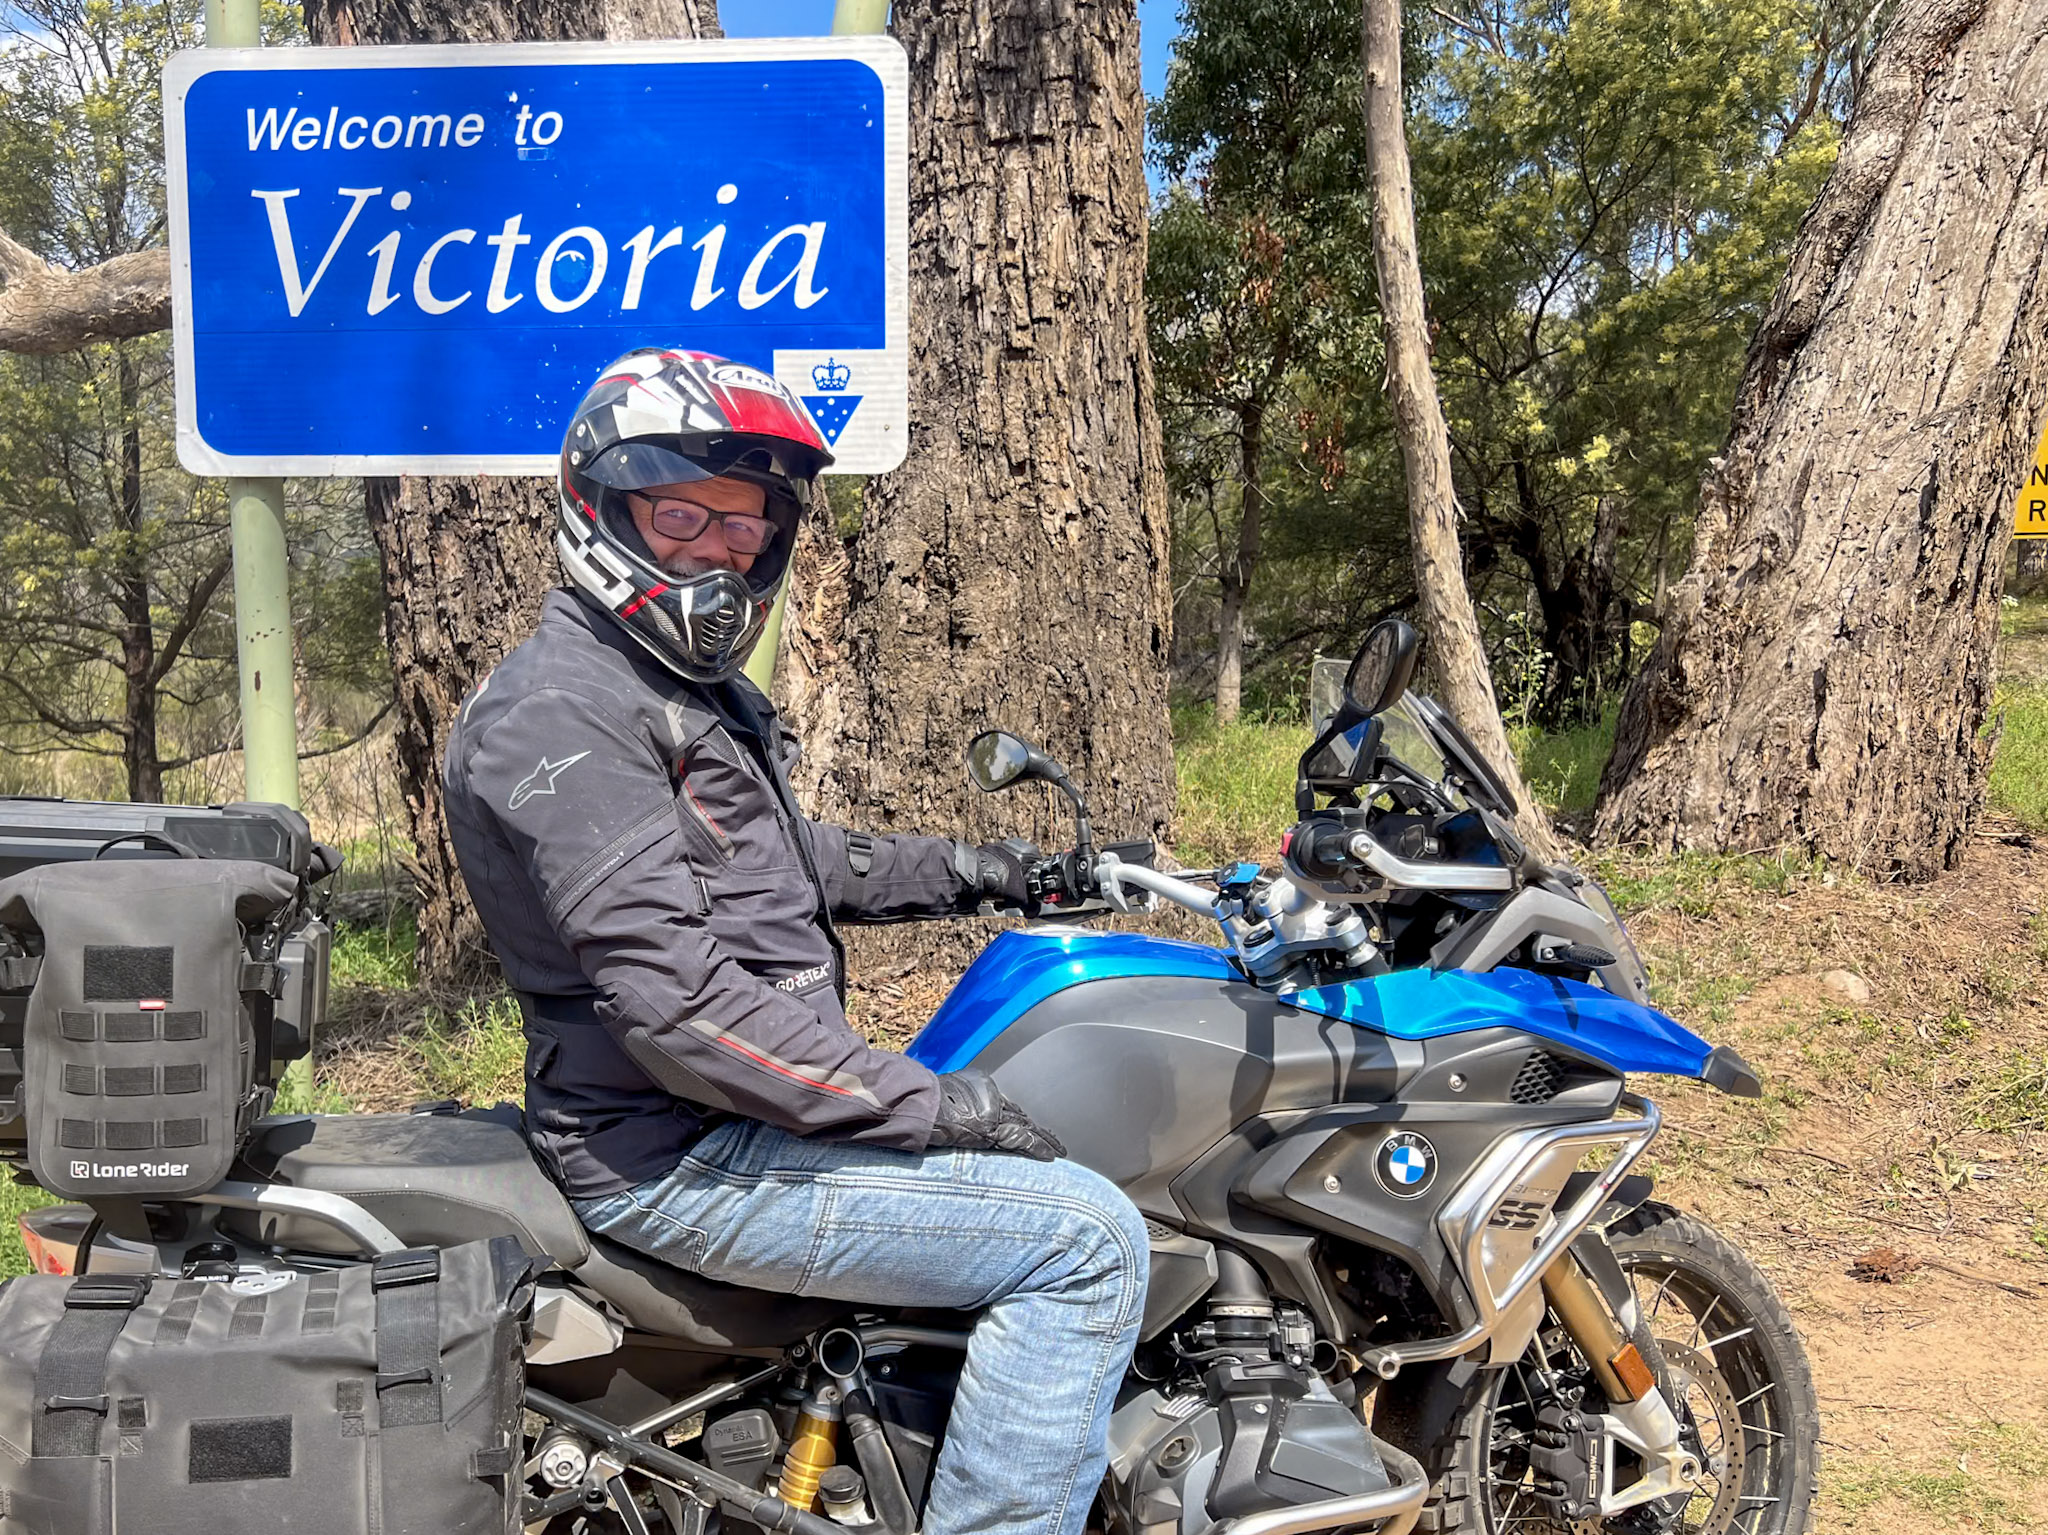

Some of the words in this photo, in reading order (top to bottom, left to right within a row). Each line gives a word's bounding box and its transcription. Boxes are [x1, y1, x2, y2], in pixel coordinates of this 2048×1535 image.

[246, 106, 485, 151] Welcome
[514, 104, 564, 146] to
[251, 183, 829, 318] Victoria
[1386, 1134, 1433, 1159] BMW
[732, 1430, 753, 1442] ESA
